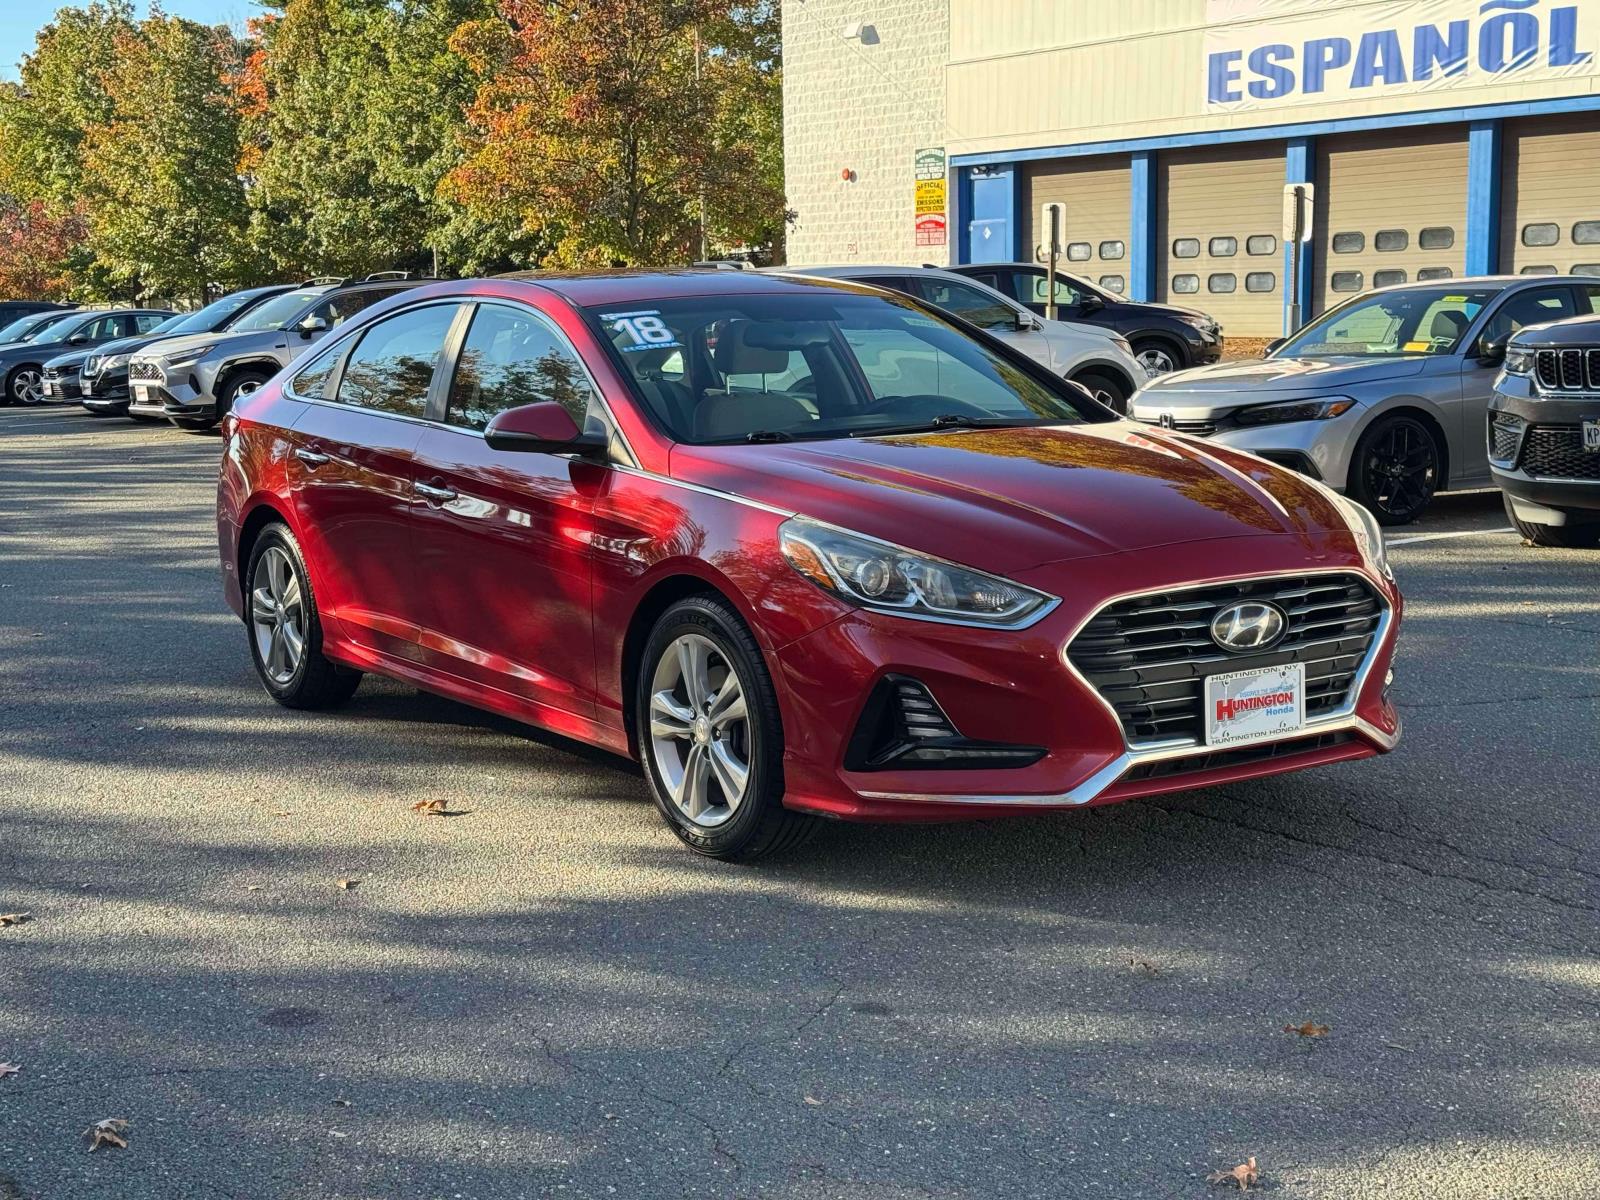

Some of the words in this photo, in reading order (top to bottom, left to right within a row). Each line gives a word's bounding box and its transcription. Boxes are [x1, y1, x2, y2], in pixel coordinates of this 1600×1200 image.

[916, 182, 943, 191] OFFICIAL
[612, 316, 675, 345] 18
[1586, 428, 1600, 444] KP
[1211, 667, 1280, 682] HUNTINGTON,
[1216, 691, 1294, 722] HUNTINGTON
[1266, 705, 1294, 717] Honda
[1212, 731, 1267, 745] HUNTINGTON
[1269, 726, 1300, 736] HONDA
